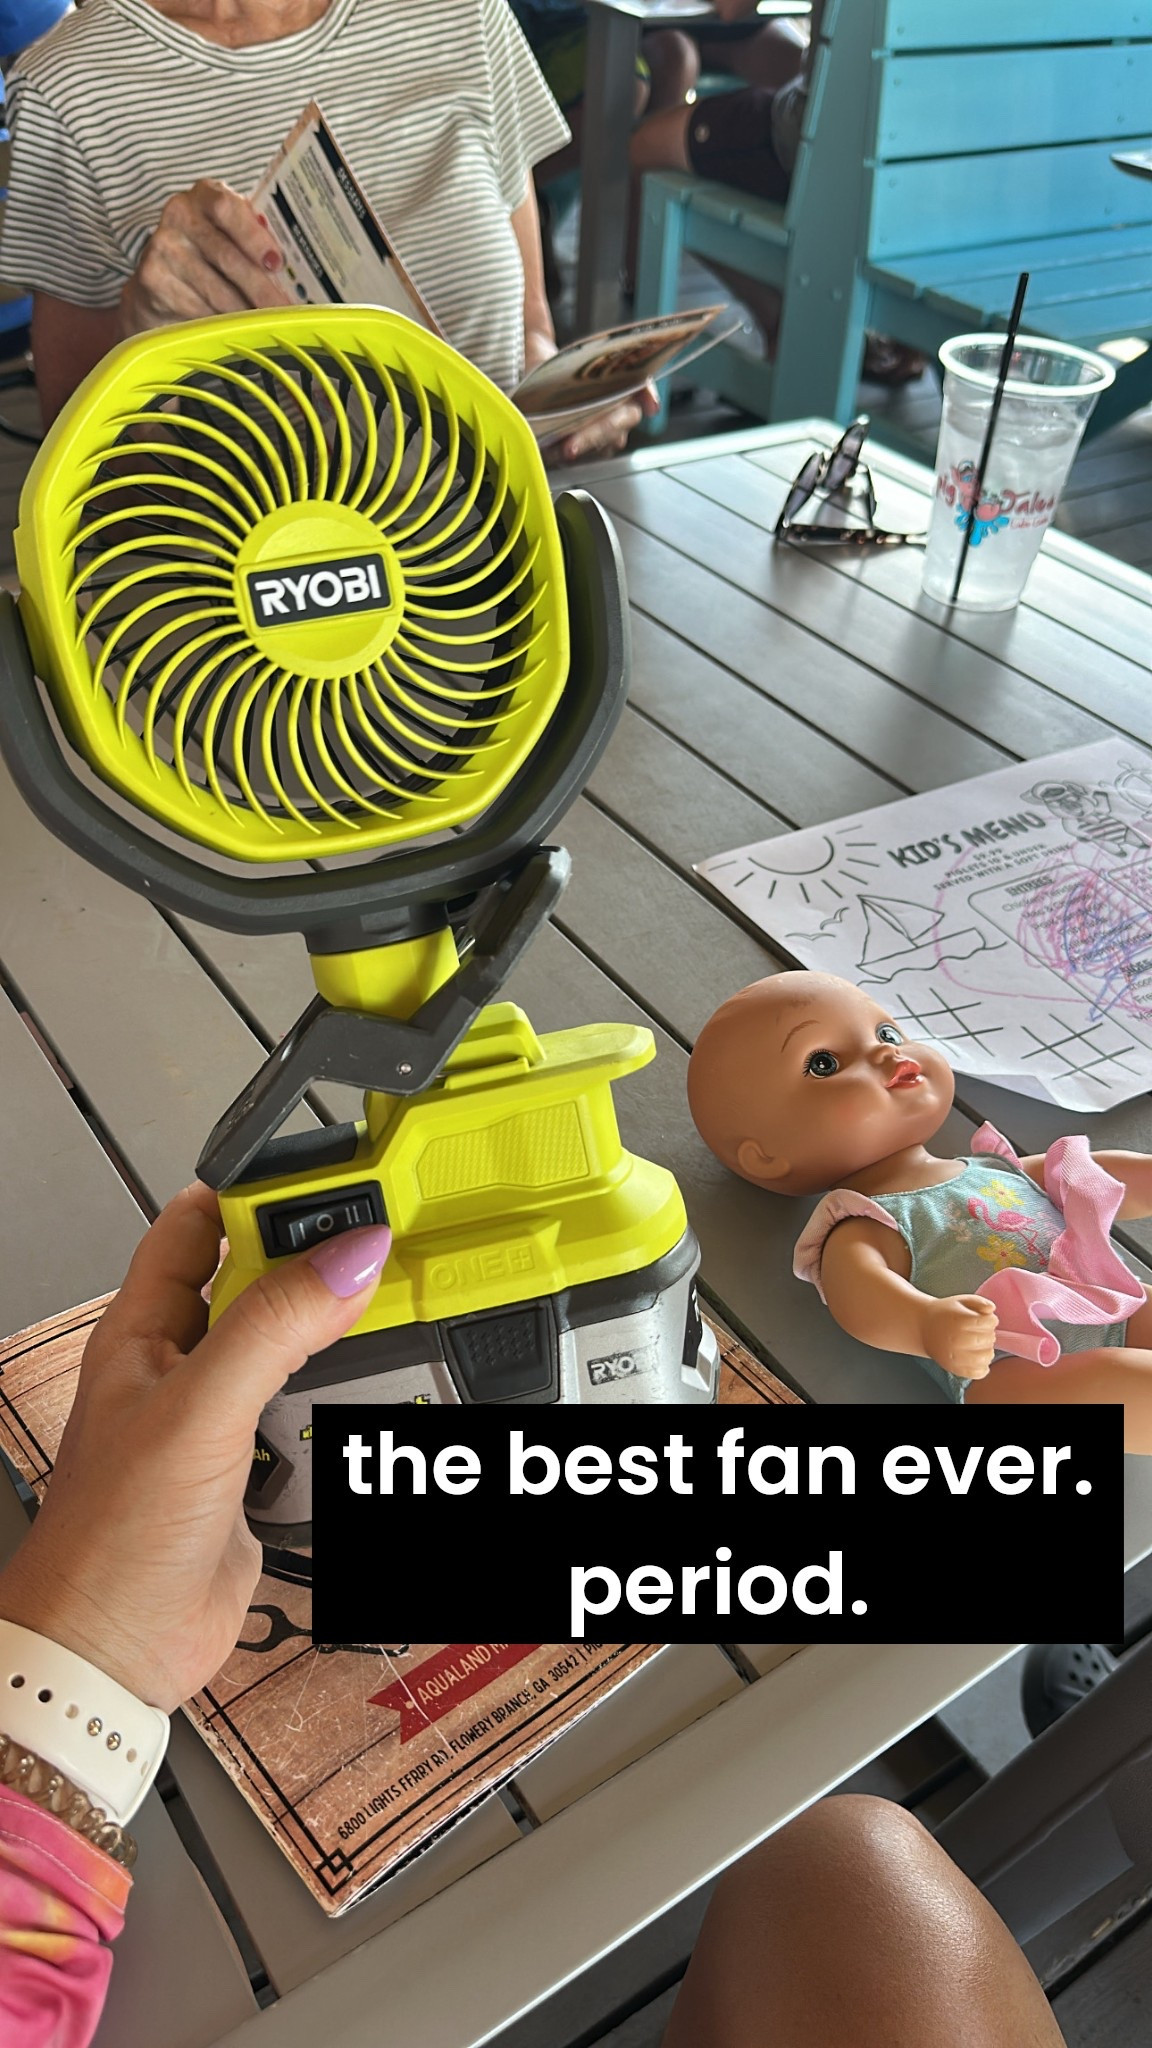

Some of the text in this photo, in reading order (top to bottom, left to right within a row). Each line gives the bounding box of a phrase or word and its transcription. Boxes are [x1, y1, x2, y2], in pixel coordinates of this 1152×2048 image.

[254, 564, 382, 617] RYOBI
[887, 811, 1046, 868] KID'S MENU
[1011, 843, 1047, 857] UNDER
[933, 874, 973, 890] SERVED
[974, 864, 1002, 878] WITH
[1013, 853, 1039, 866] SOFT
[417, 1645, 492, 1705] AQUALAND
[337, 1812, 366, 1840] 6800
[362, 1784, 402, 1818] LIGHTS
[449, 1717, 496, 1754] FLOWERY
[532, 1677, 551, 1693] GA
[547, 1654, 580, 1682] 30542
